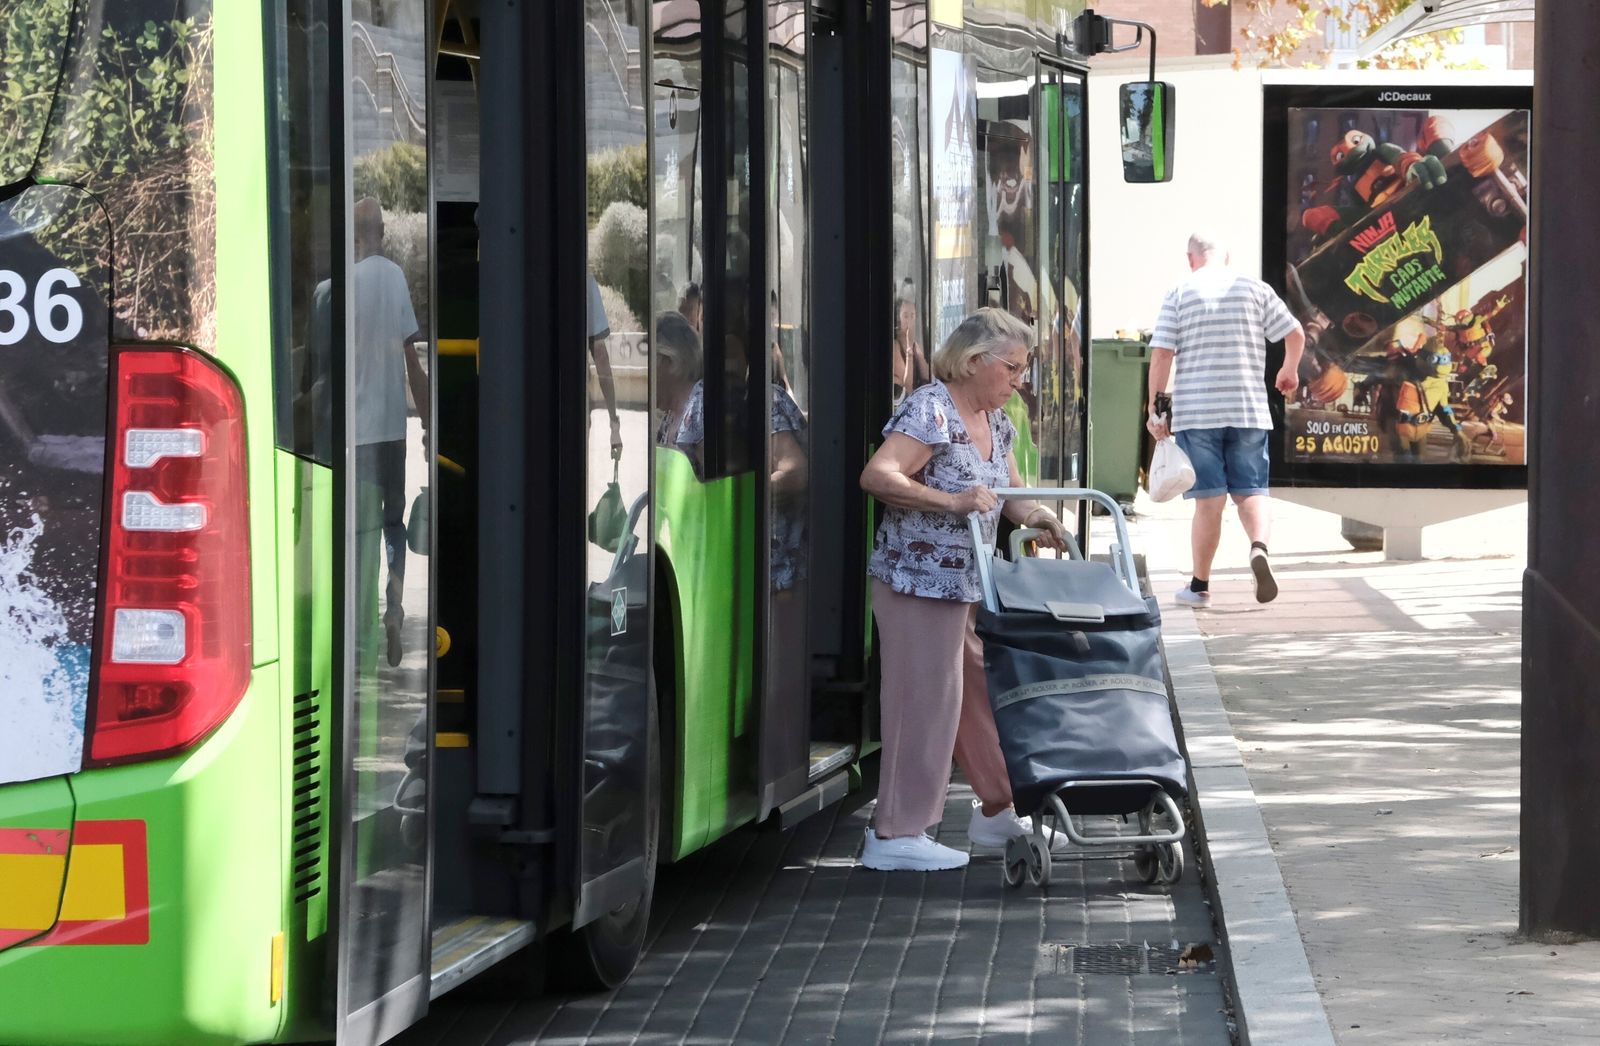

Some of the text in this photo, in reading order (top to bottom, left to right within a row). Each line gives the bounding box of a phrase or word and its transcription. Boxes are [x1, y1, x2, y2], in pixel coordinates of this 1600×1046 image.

[1378, 91, 1431, 101] JCDecaux
[1349, 211, 1397, 253] NINJA
[1344, 215, 1442, 303] TURTLES
[1389, 258, 1423, 287] CAOS
[1390, 264, 1447, 309] MUTANTE
[1307, 420, 1368, 435] SOLO EN CINES
[1296, 435, 1379, 454] 25 AGOSTO
